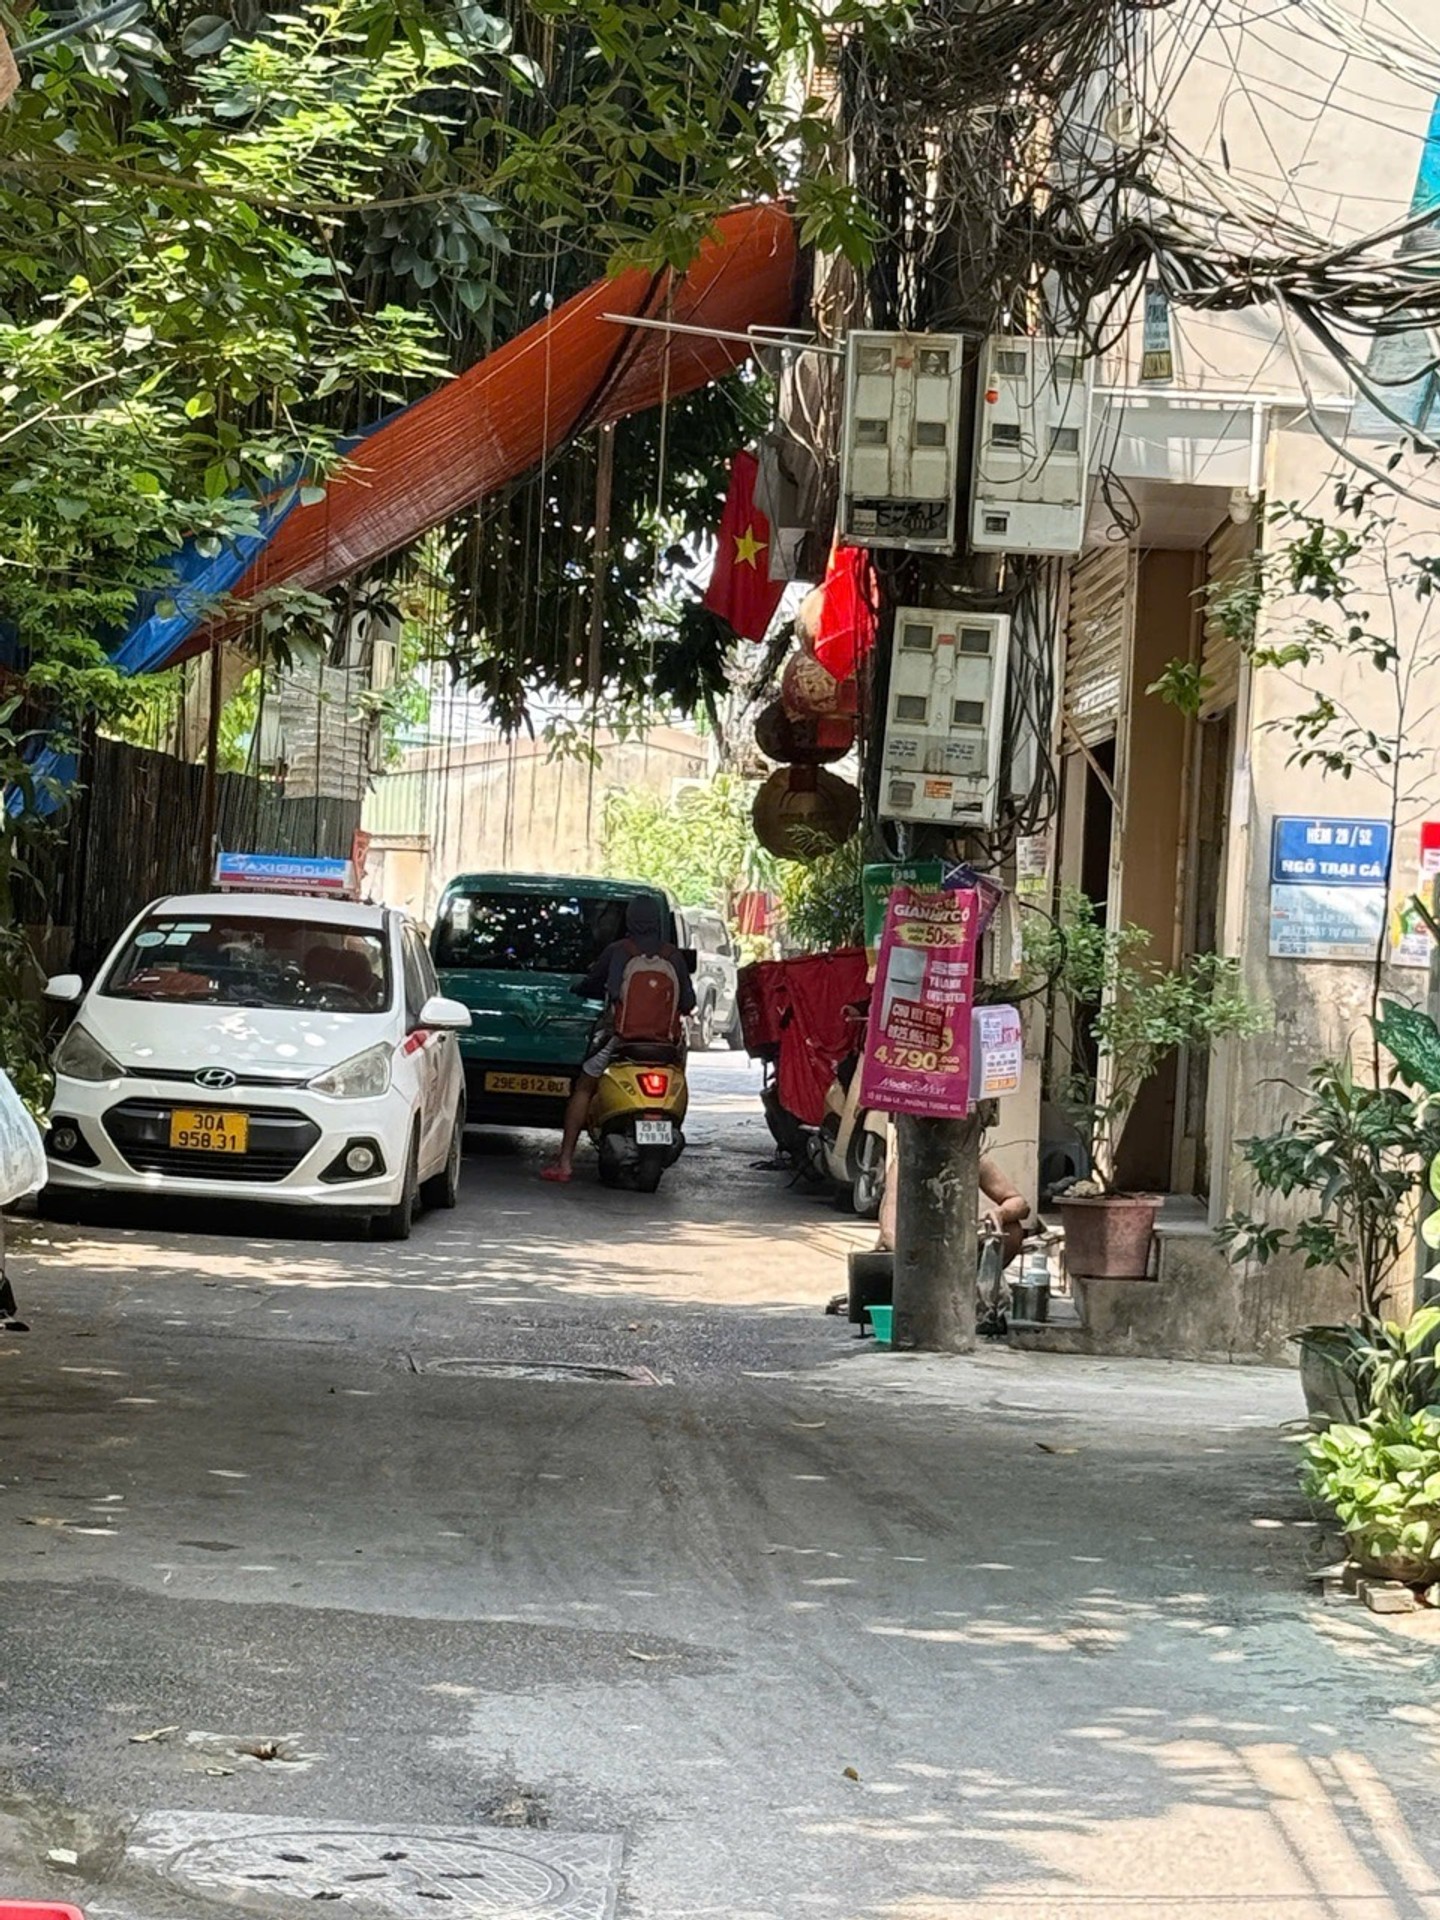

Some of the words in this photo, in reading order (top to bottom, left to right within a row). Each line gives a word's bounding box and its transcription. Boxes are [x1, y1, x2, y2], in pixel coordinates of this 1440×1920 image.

[1281, 858, 1316, 874] NGÕ
[1319, 862, 1356, 878] TRẠI
[874, 1045, 938, 1071] 4.790
[192, 1113, 226, 1131] 30A
[178, 1130, 237, 1150] 958.31
